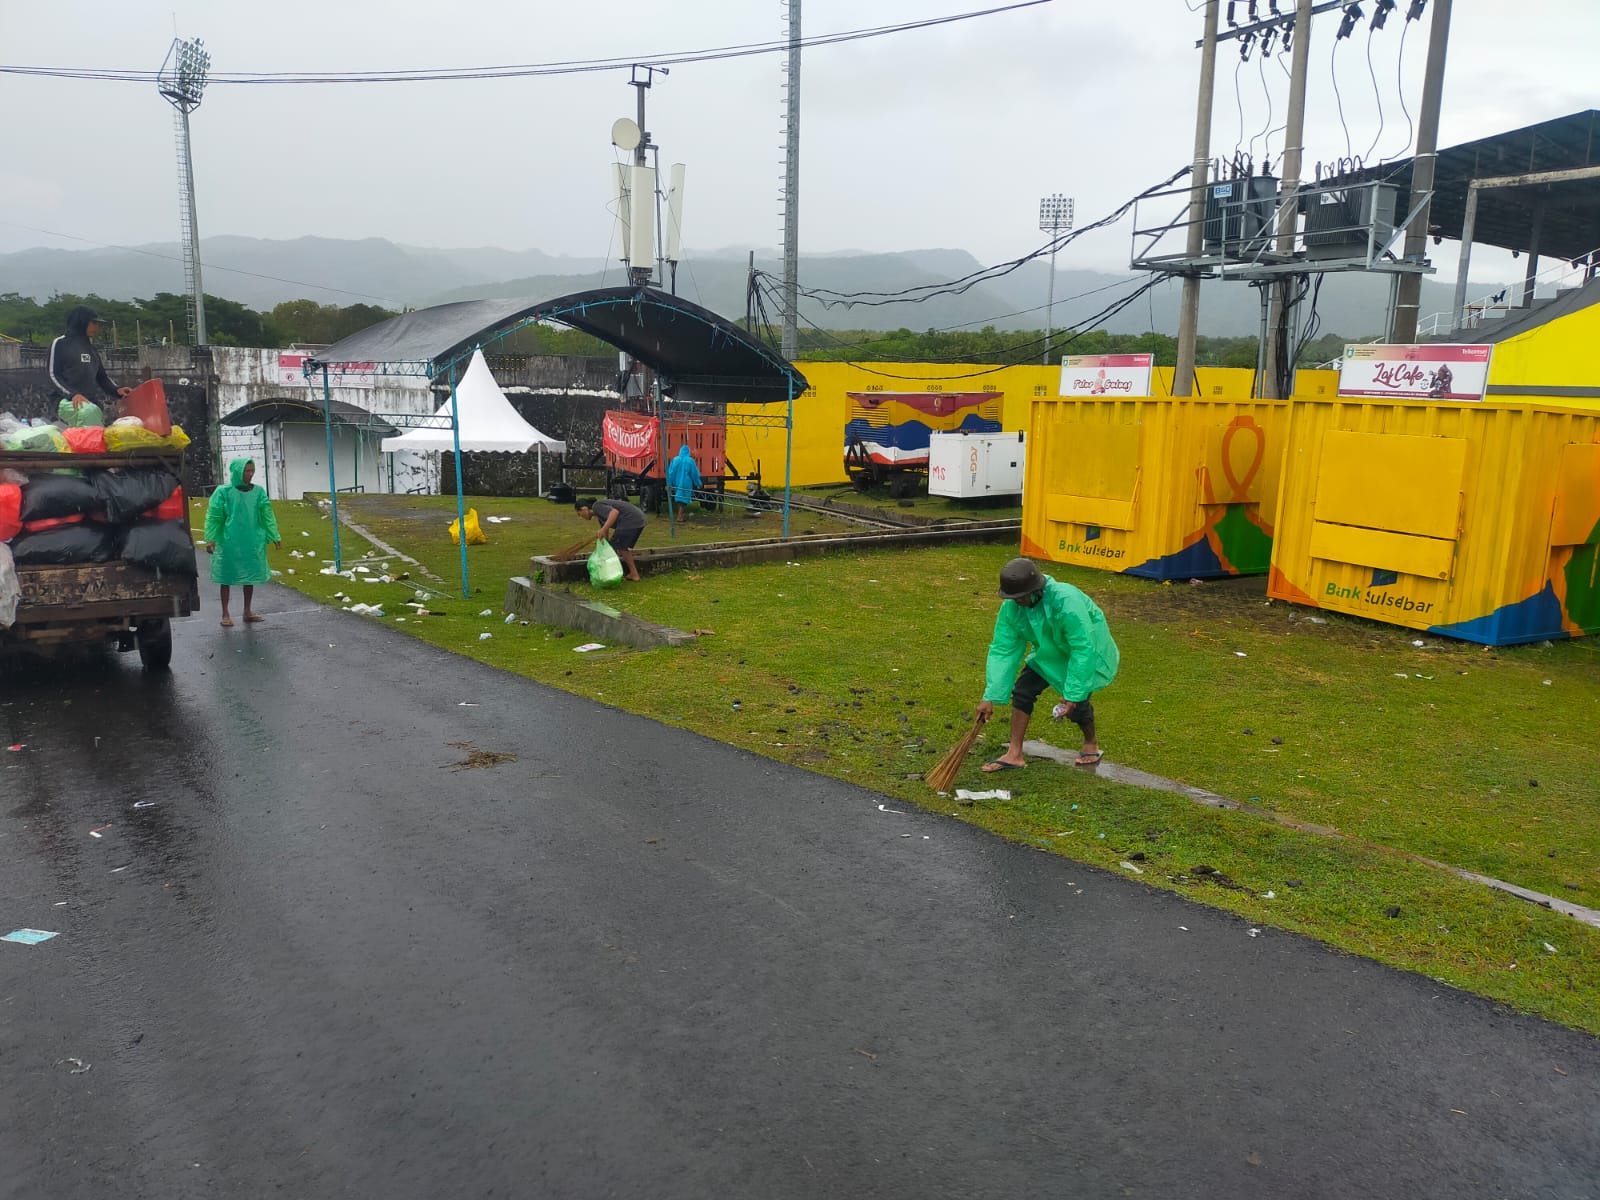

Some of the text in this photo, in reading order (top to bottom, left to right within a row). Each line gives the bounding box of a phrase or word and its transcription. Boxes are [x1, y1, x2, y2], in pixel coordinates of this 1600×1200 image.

[1394, 363, 1425, 387] Cafe
[932, 465, 946, 480] MS
[1059, 540, 1081, 554] Bnk
